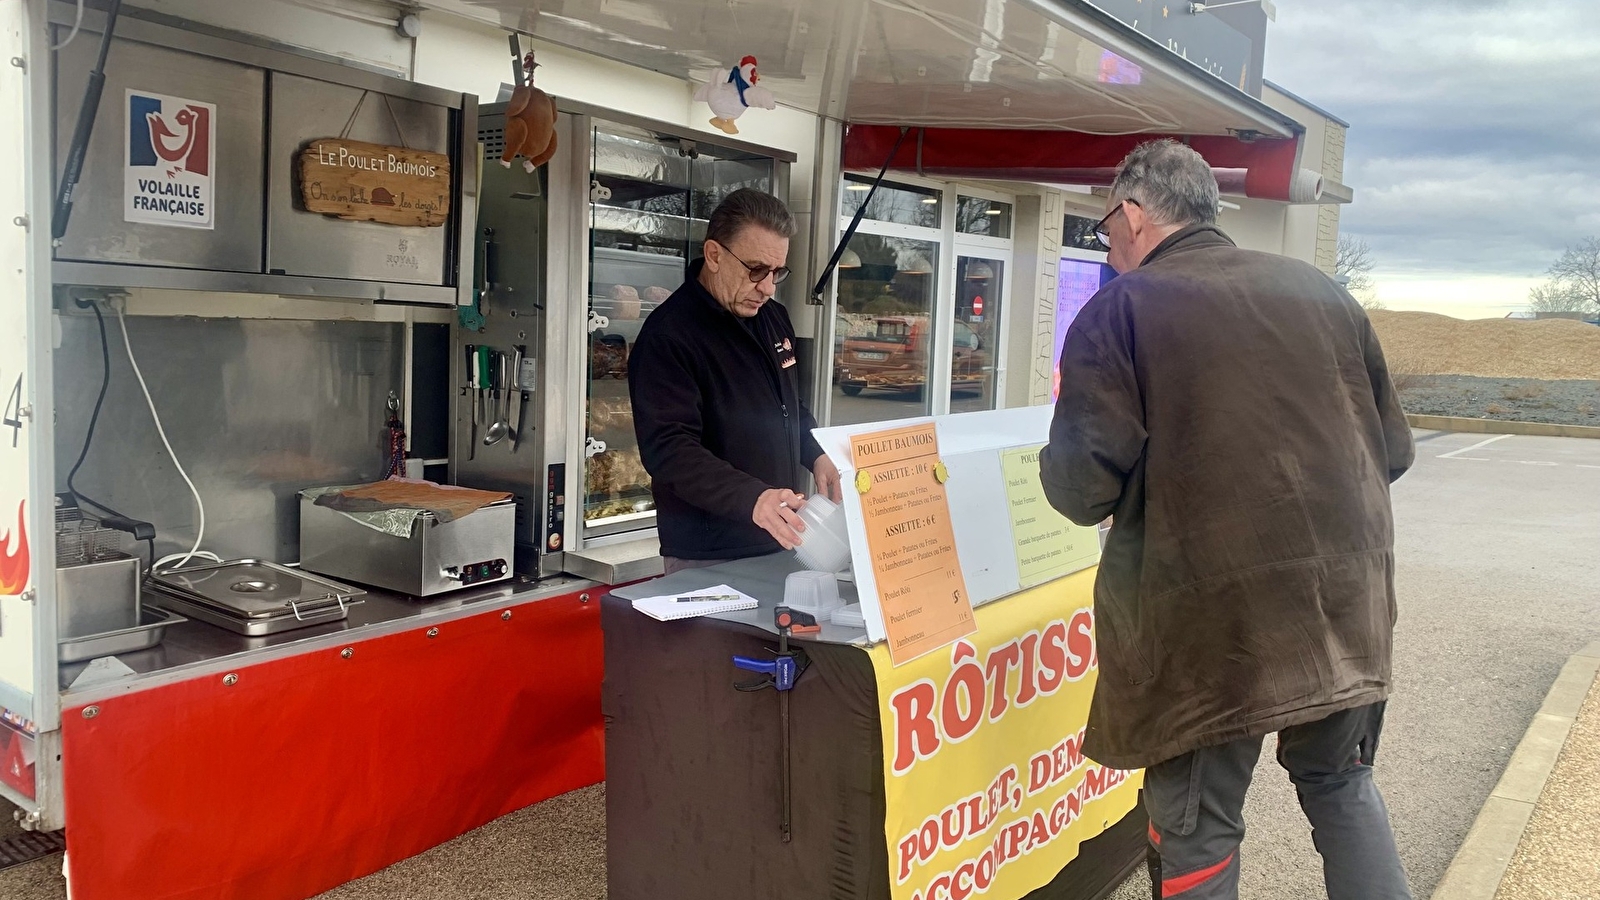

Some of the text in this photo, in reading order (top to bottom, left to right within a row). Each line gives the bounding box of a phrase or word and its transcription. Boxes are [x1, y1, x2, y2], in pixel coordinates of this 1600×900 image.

[340, 147, 385, 171] POULET
[138, 178, 200, 199] VOLAILLE
[310, 181, 329, 201] On
[399, 191, 412, 209] les
[133, 196, 205, 216] FRANÇAISE
[386, 254, 419, 265] ROYAL
[857, 432, 934, 456] POULET BAUMOIS
[873, 467, 910, 485] ASSIETTE
[873, 495, 888, 505] Poulet
[892, 490, 909, 500] Patates
[915, 486, 929, 495] Frites
[874, 503, 903, 517] Jambonneau
[907, 498, 924, 508] Patates
[929, 493, 943, 502] Frites
[884, 519, 922, 538] ASSIETTE
[882, 549, 898, 560] Poulet
[902, 544, 919, 554] Patates
[925, 538, 938, 547] Frites
[884, 556, 913, 572] Jambonneau
[917, 551, 933, 561] Patates
[939, 544, 952, 554] Frites
[884, 590, 901, 601] Poulet
[900, 585, 911, 595] Rôti
[890, 612, 906, 624] Poulet
[906, 606, 923, 618] fermier
[896, 631, 925, 648] Jambonneau
[892, 608, 1098, 772] RÔTISS
[898, 729, 1087, 881] POULET, DEM
